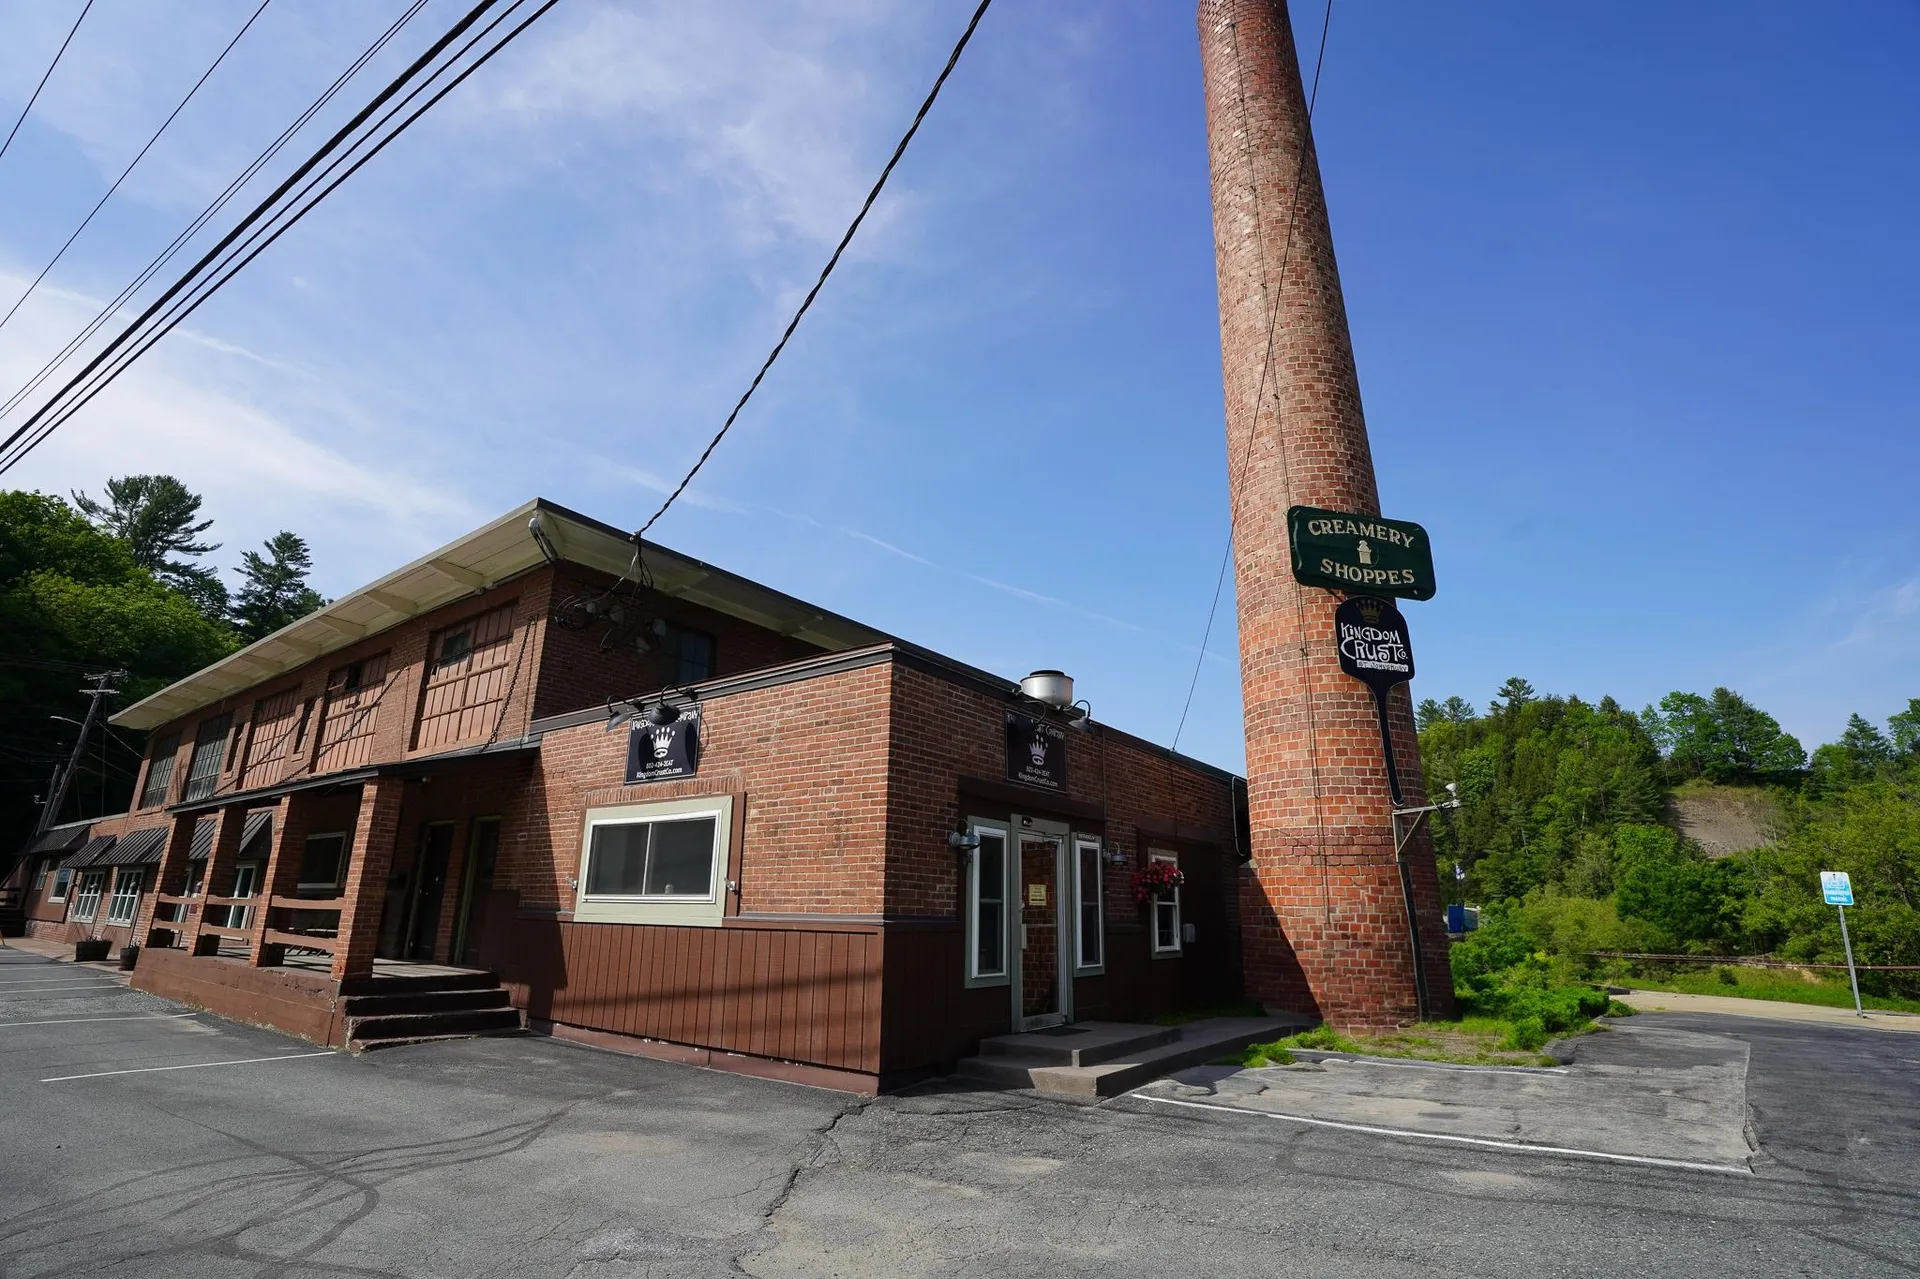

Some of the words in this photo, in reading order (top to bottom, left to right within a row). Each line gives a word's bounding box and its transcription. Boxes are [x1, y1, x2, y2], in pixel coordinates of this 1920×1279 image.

[1307, 519, 1415, 548] CREAMERY
[1320, 558, 1415, 585] SHOPPES
[1340, 635, 1404, 663] CRUST
